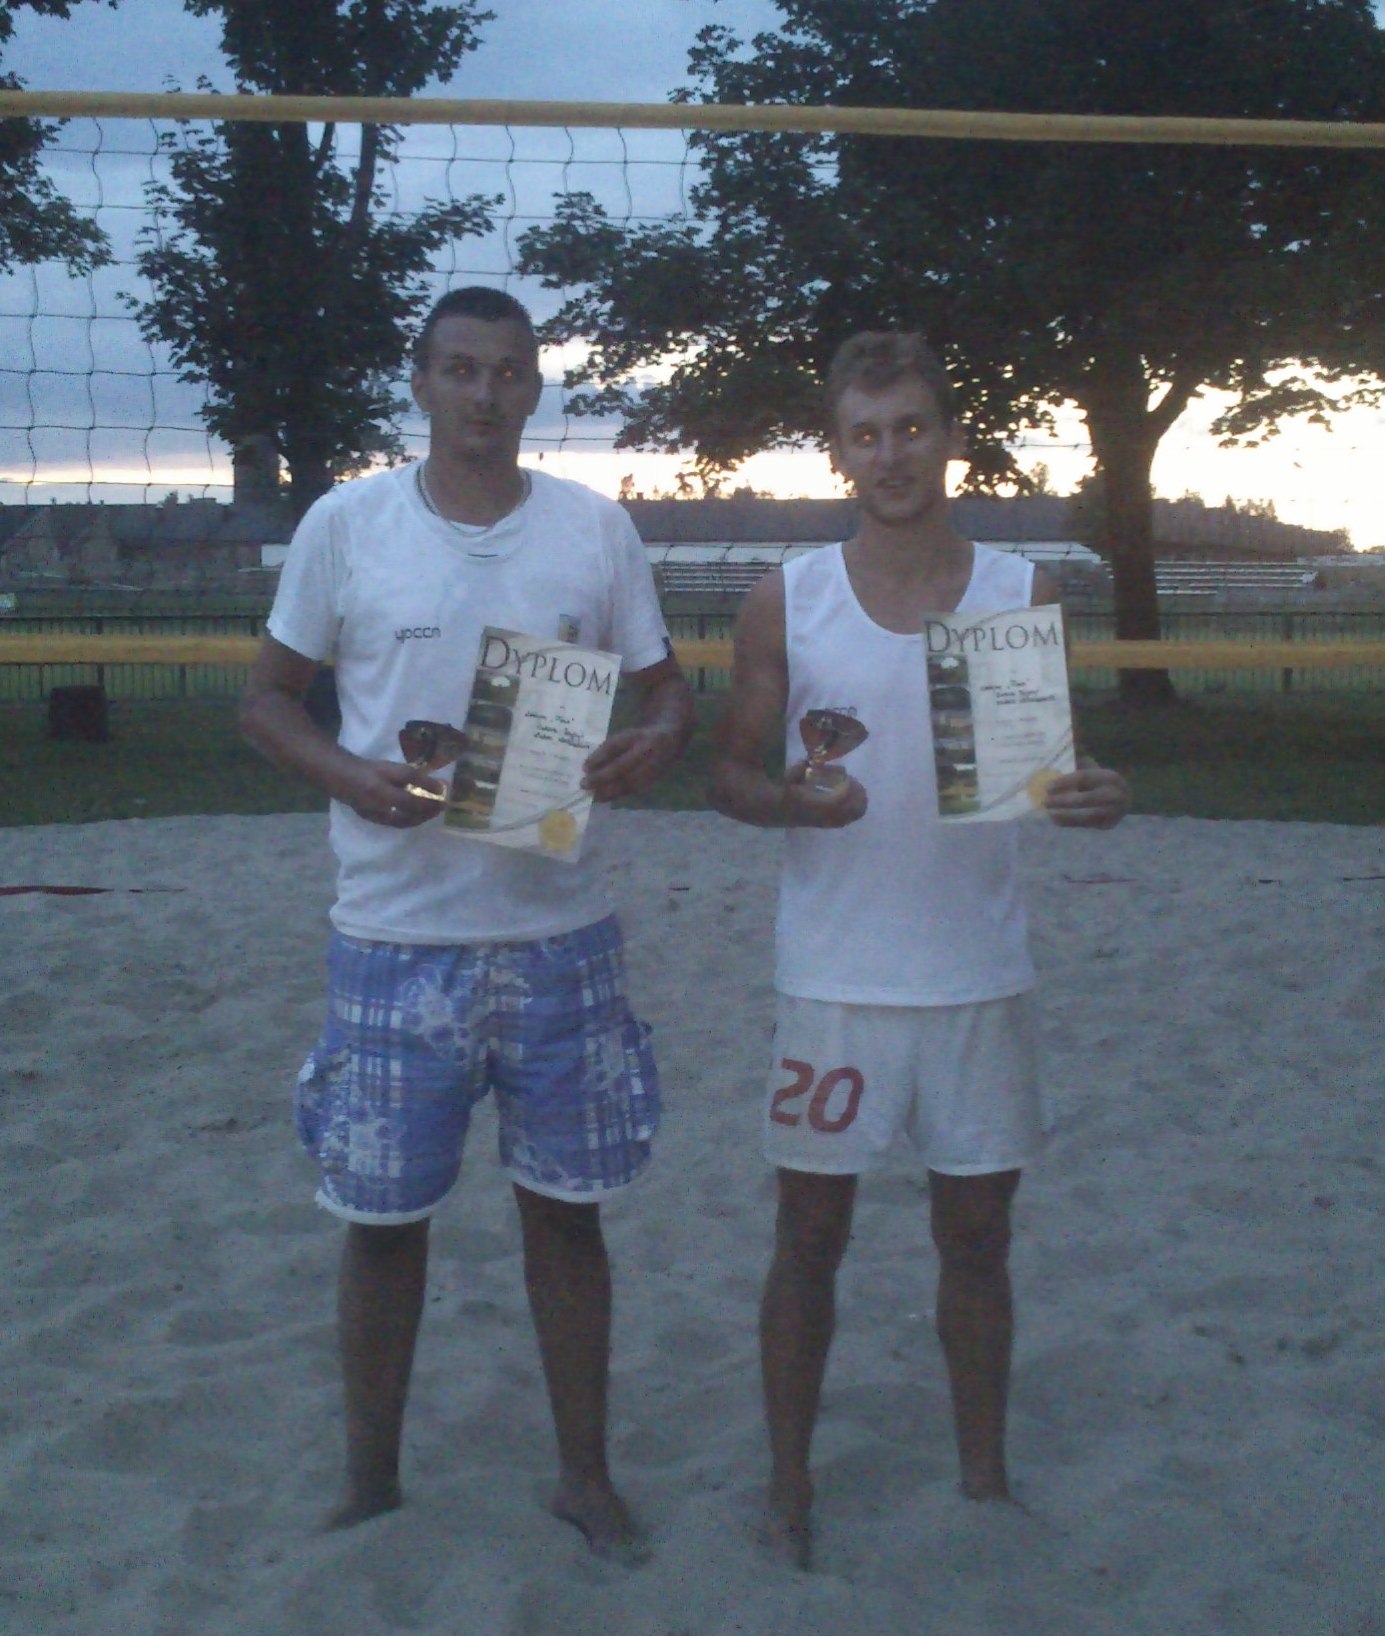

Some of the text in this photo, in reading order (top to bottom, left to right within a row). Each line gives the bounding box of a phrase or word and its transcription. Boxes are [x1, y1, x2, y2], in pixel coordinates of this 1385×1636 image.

[480, 635, 612, 695] DYPLOM
[924, 620, 1059, 653] DYPLOM
[770, 1057, 864, 1133] 20
